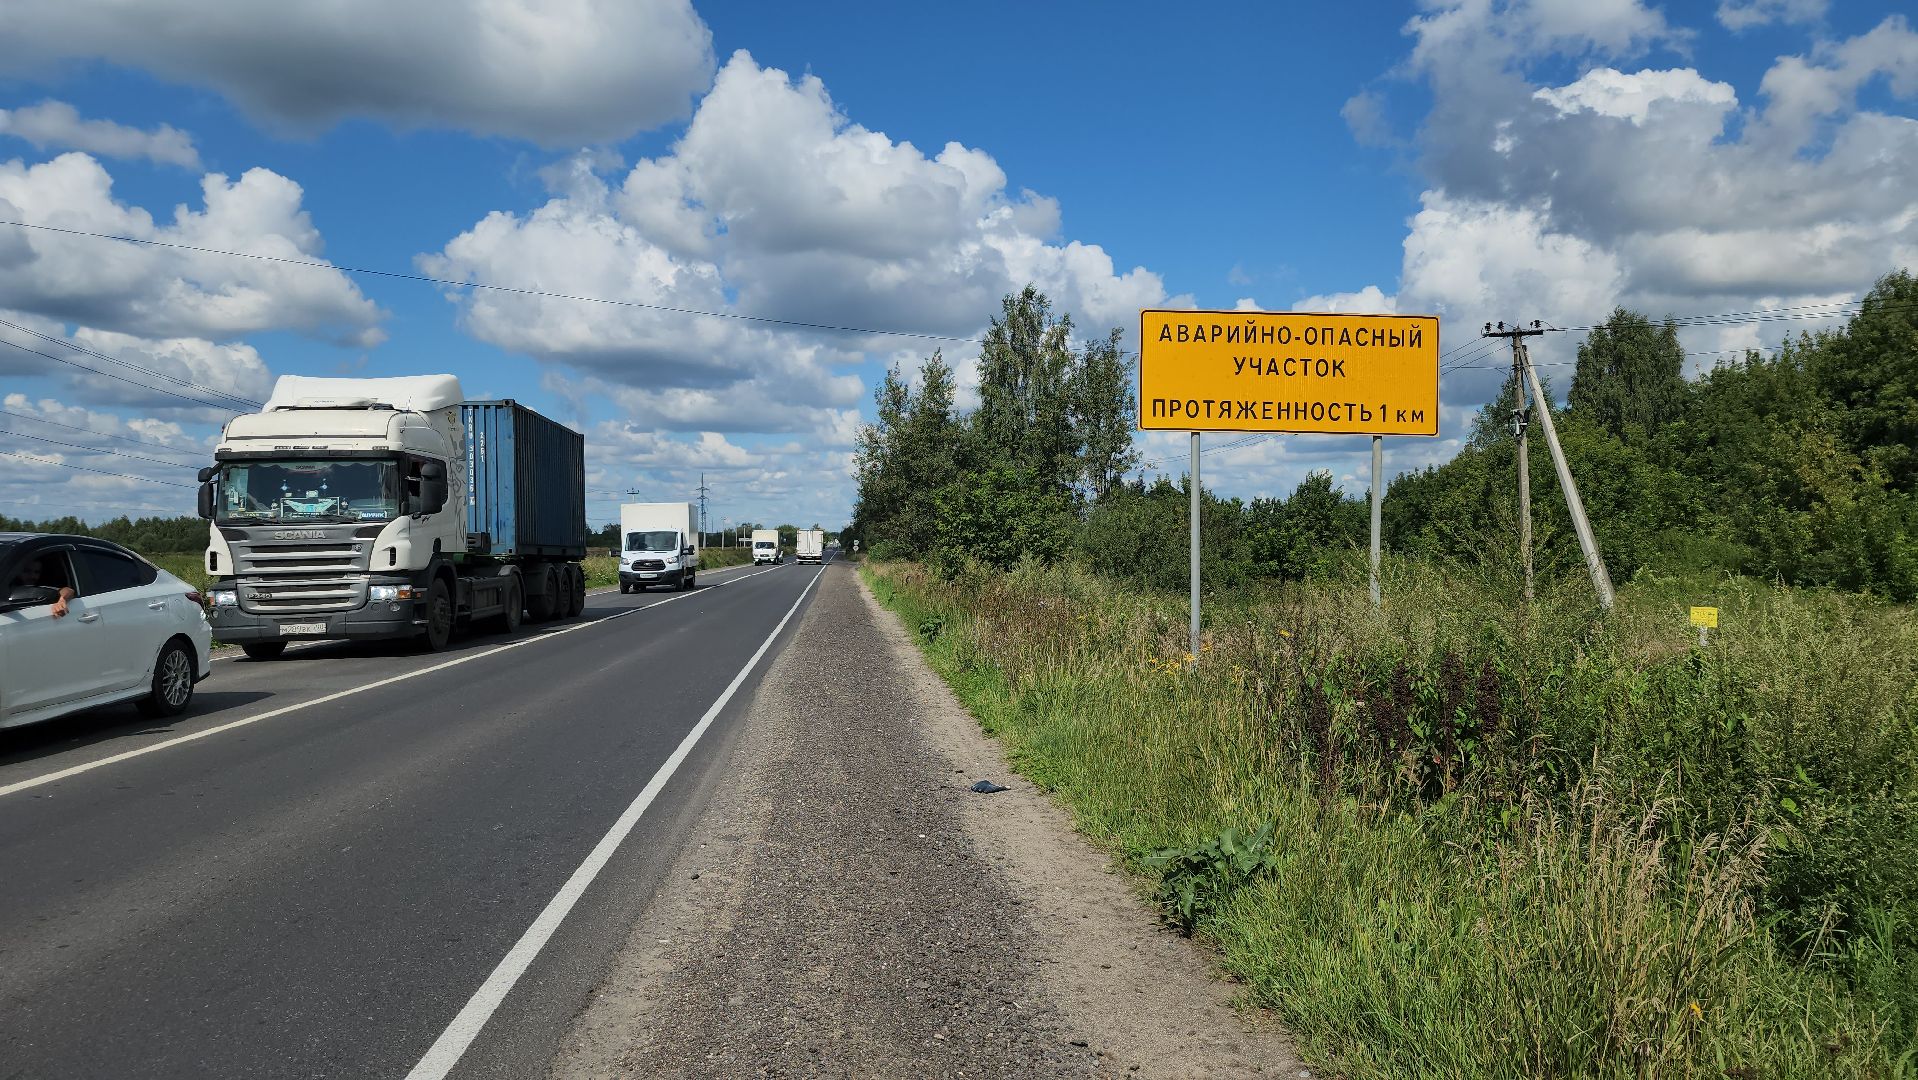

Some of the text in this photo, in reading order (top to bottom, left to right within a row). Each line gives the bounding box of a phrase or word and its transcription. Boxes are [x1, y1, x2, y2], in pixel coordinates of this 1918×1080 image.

[1159, 319, 1422, 348] АВАРИЙНО-ОПАСНЫЙ
[1233, 357, 1345, 377] УЧАСТОК
[1153, 399, 1372, 421] ПРОТЯЖЕННОСТЬ
[1380, 404, 1386, 422] 1
[274, 530, 326, 540] SCANIA
